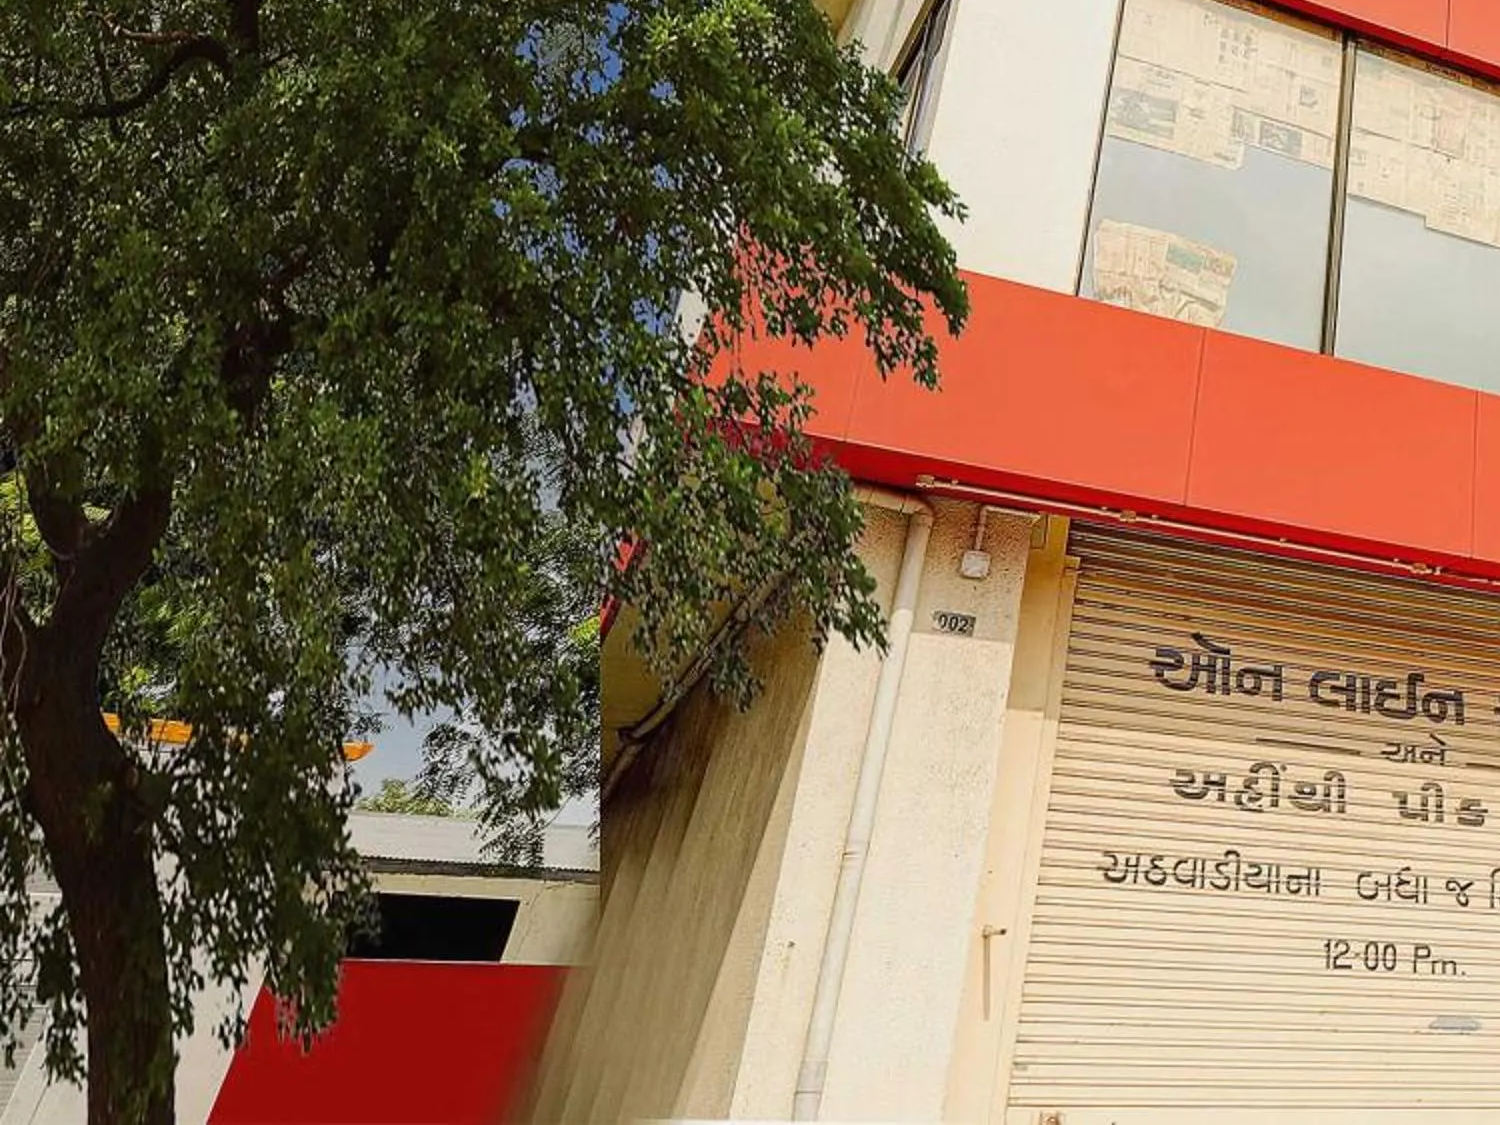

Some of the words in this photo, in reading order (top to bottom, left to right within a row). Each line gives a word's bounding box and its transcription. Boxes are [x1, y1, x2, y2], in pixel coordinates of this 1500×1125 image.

[937, 613, 969, 633] 002
[1308, 673, 1465, 725] લાઈન
[1381, 732, 1447, 766] અને
[1446, 877, 1474, 908] જ
